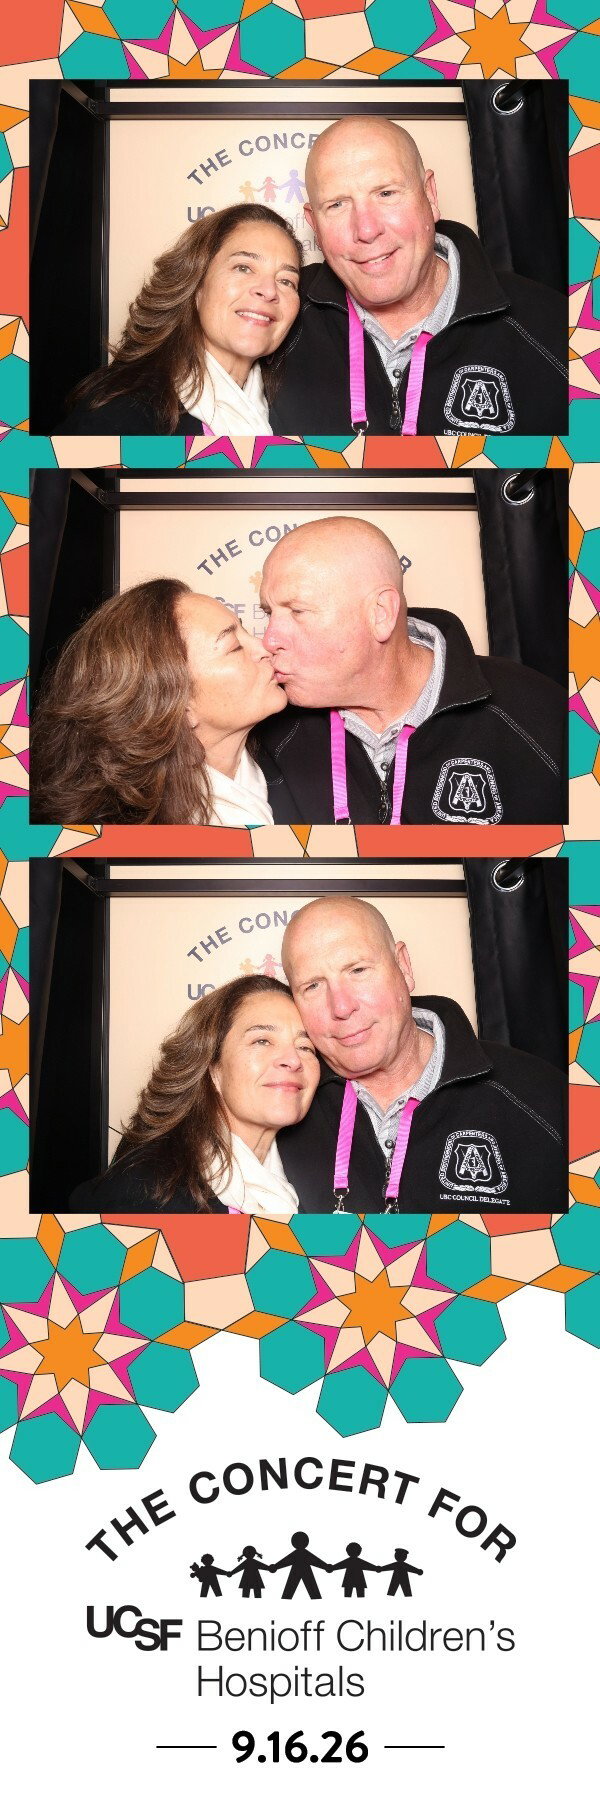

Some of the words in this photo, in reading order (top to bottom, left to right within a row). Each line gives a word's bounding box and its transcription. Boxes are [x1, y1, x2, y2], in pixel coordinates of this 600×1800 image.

[187, 149, 232, 185] THE
[238, 132, 321, 156] CONCE
[197, 539, 242, 576] THE
[187, 926, 232, 962] THE
[479, 1196, 511, 1205] DELEGATE
